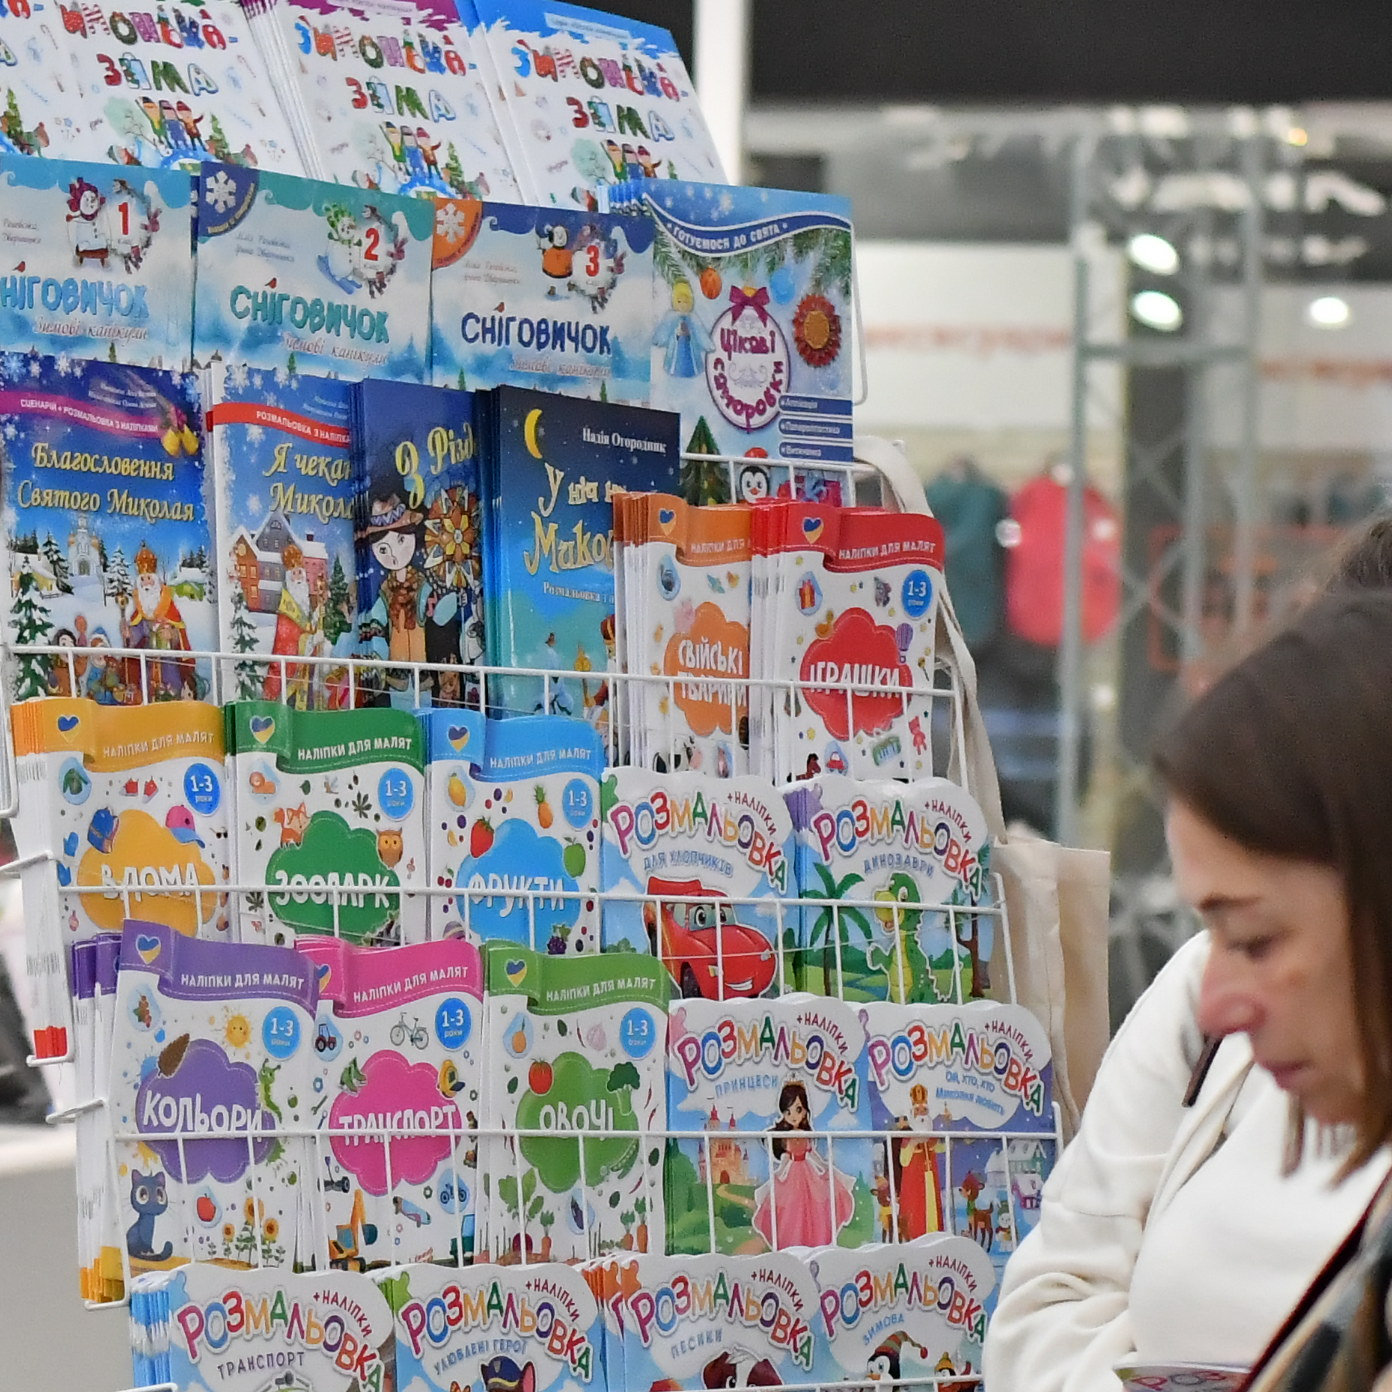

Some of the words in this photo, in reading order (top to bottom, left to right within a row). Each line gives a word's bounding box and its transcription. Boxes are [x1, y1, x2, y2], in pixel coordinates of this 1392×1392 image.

[96, 52, 218, 96] ЗИМА
[346, 76, 456, 122] ЗИМА
[566, 96, 675, 142] ЗИМА
[118, 202, 130, 235] 1
[733, 236, 747, 250] ДО
[750, 223, 781, 241] СВЯТА
[364, 228, 380, 261] 2
[586, 245, 600, 277] 3
[230, 285, 390, 344] СНІГОВИЧОК
[461, 312, 611, 356] СНІГОВИЧОК
[256, 410, 312, 435] РОЗМАЛЬОВКА
[320, 430, 351, 443] НАЛІПКА
[583, 427, 609, 445] Надія
[611, 432, 667, 454] Огородник
[32, 442, 174, 481] Благословення
[263, 442, 293, 477] Я
[427, 421, 476, 475] Різд
[18, 480, 100, 511] Святого
[107, 488, 194, 524] Миколая
[269, 482, 354, 524] Микол
[538, 462, 564, 517] У
[524, 511, 614, 576] Мико
[839, 546, 879, 560] НАЛІПКИ
[881, 544, 901, 557] ДЛЯ
[903, 541, 936, 555] МАЛЯТ
[908, 581, 928, 597] 1-3
[678, 636, 744, 676] СВІЙСЬКІ
[809, 661, 901, 699] ІГРАШКИ
[104, 743, 149, 758] НАЛІПКИ
[151, 736, 173, 750] ДЛЯ
[176, 731, 214, 745] МАЛЯТ
[298, 744, 345, 760] НАЛІПКИ
[348, 739, 371, 755] ДЛЯ
[374, 736, 412, 751] МАЛЯТ
[490, 755, 533, 769] НАЛІПКИ
[536, 751, 556, 764] ДЛЯ
[559, 748, 592, 761] МАЛЯТ
[190, 775, 212, 793] 1-3
[385, 780, 407, 797] 1-3
[568, 790, 587, 807] 1-3
[609, 791, 787, 891] РОЗМАЛЬОВКА
[812, 800, 982, 898] РОЗМАЛЬОВКА
[644, 850, 666, 871] ДЛЯ
[275, 869, 390, 909] ЗООПАРК
[468, 872, 565, 918] ФРУКТИ
[181, 973, 232, 988] НАЛІПКИ
[234, 973, 260, 987] ДЛЯ
[262, 973, 305, 990] МАЛЯТ
[354, 984, 401, 1004] НАЛІПКИ
[404, 974, 427, 991] ДЛЯ
[429, 966, 469, 982] МАЛЯТ
[546, 984, 591, 1001] НАЛІПКИ
[593, 980, 615, 996] ДЛЯ
[617, 977, 656, 990] МАЛЯТ
[269, 1017, 294, 1037] 1-3
[441, 1010, 464, 1028] 1-3
[627, 1019, 648, 1036] 1-3
[676, 1016, 859, 1109] РОЗМАЛЬОВКА
[870, 1022, 1042, 1114] РОЗМАЛЬОВКА
[715, 1074, 778, 1098] ПРИНЦЕСИ
[143, 1090, 263, 1142] КОЛЬОРИ
[339, 1104, 457, 1147] ТРАНСПОРТ
[539, 1099, 614, 1141] ОВОЧІ
[631, 1272, 812, 1367] РОЗМАЛЬОВКА
[820, 1262, 986, 1343] РОЗМАЛЬОВКА
[401, 1281, 591, 1380] РОЗМАЛЬОВКА
[671, 1328, 723, 1360] ПЕСИКИ
[863, 1313, 904, 1345] ЗИМОВА
[218, 1352, 305, 1380] ТРАНСПОРТ
[434, 1343, 488, 1375] УЛЮБЛЕНІ
